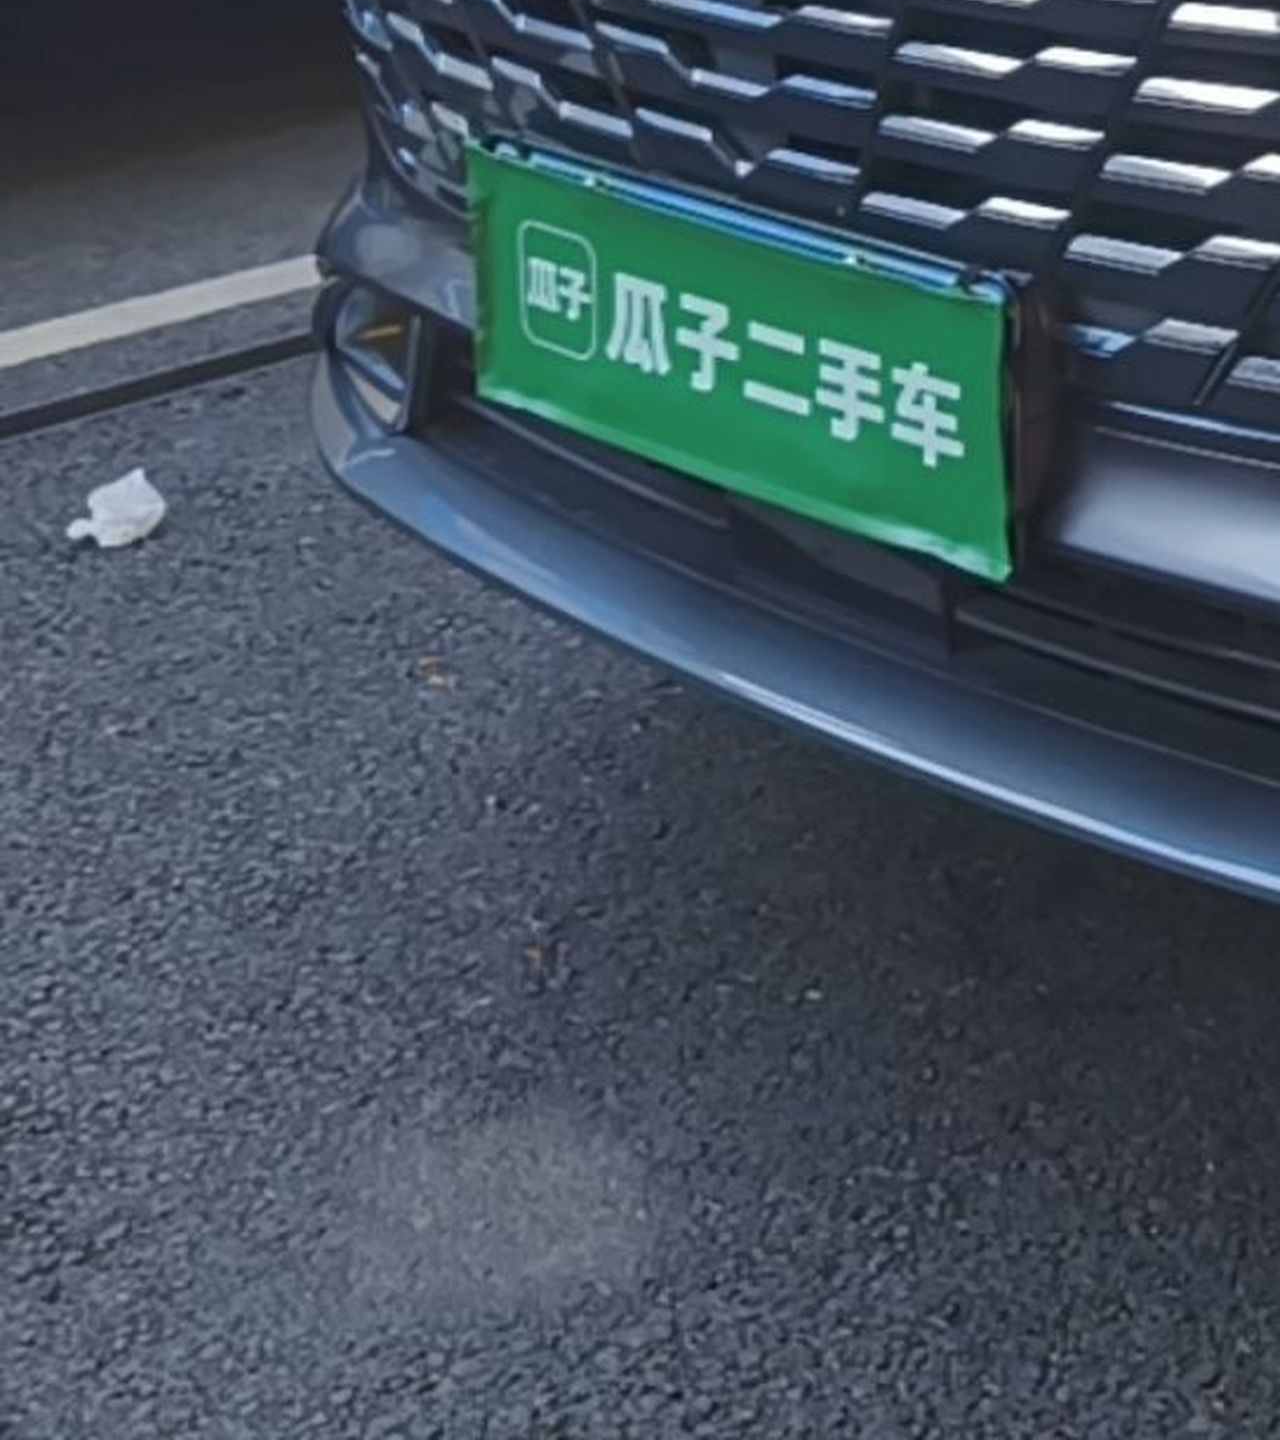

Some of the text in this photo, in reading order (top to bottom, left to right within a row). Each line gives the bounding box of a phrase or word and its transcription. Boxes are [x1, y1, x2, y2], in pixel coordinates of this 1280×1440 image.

[605, 272, 965, 468] 瓜子二手车
